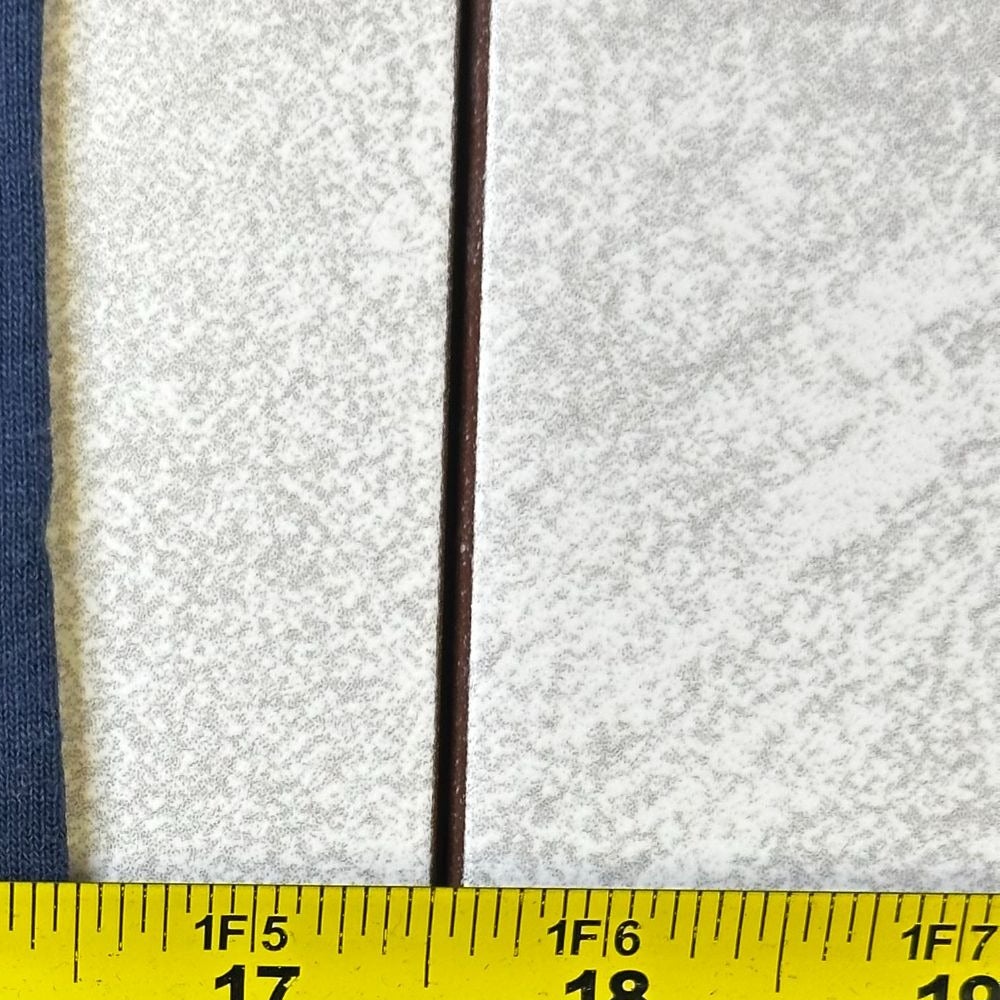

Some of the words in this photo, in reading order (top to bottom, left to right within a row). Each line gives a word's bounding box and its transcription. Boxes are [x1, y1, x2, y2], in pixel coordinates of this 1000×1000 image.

[194, 915, 247, 950] 1F
[262, 915, 288, 952] 5
[547, 920, 602, 956] 1F
[614, 920, 641, 956] 6
[901, 924, 957, 960] 1F
[971, 925, 999, 961] 7
